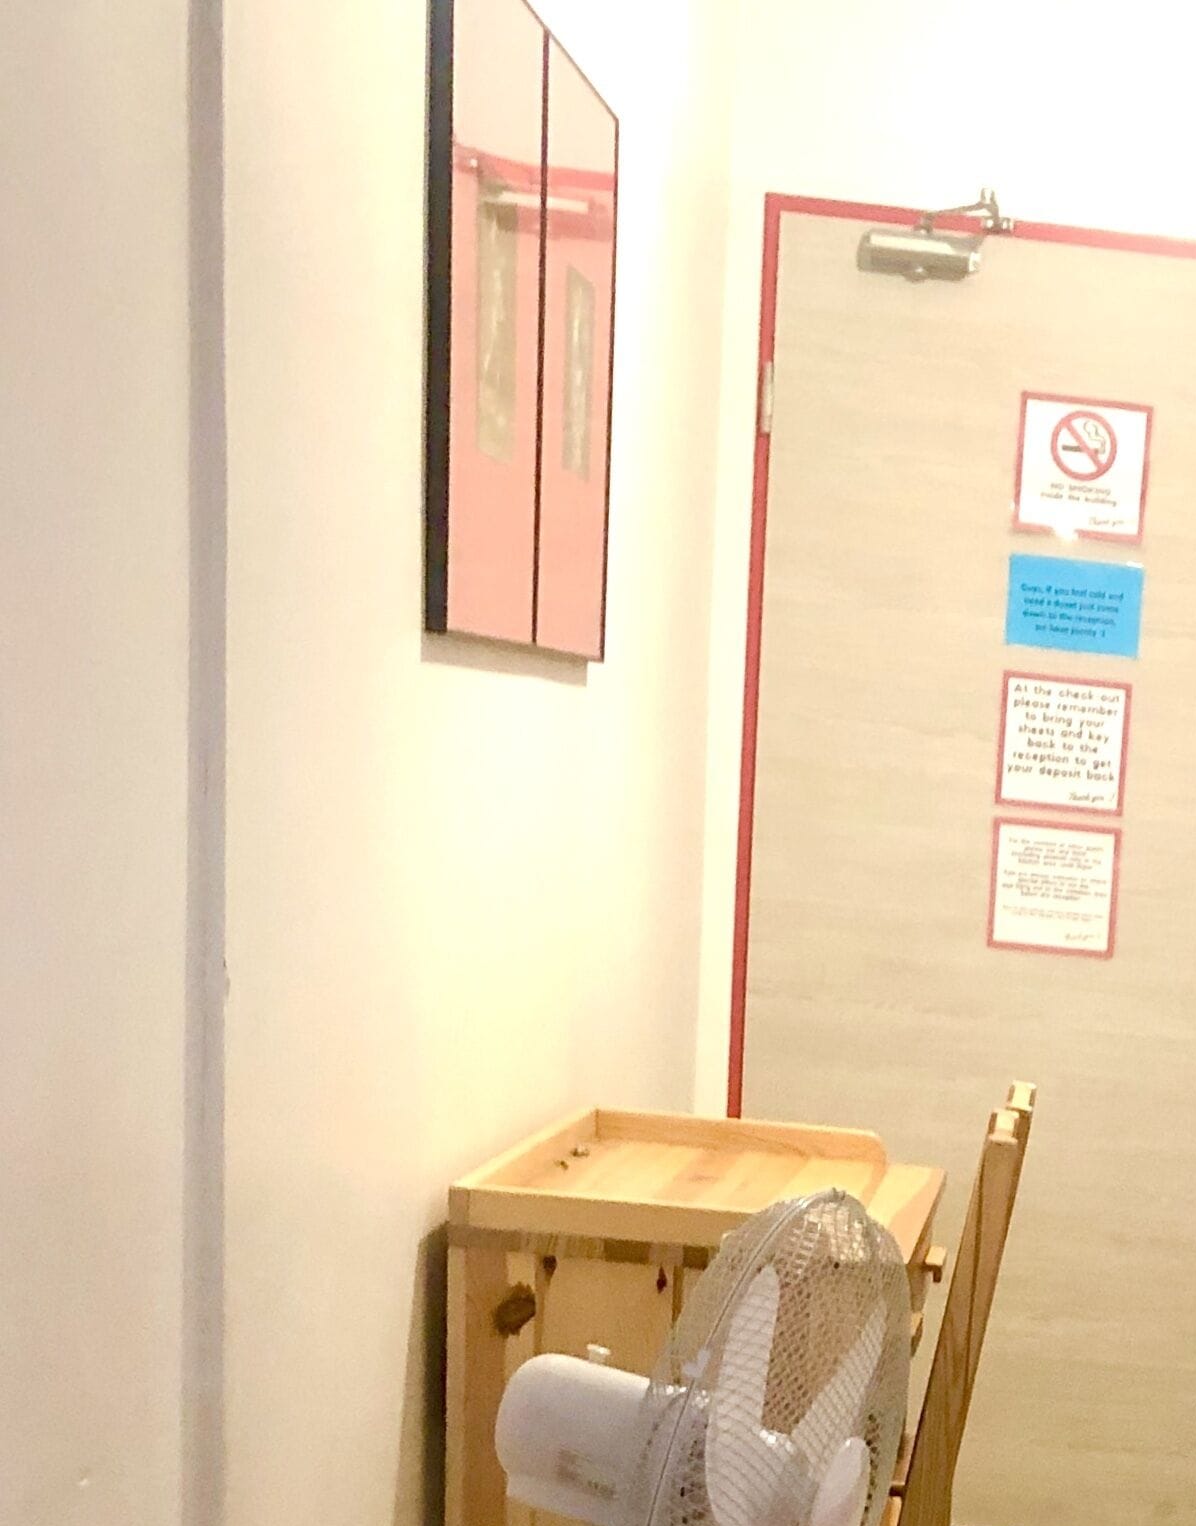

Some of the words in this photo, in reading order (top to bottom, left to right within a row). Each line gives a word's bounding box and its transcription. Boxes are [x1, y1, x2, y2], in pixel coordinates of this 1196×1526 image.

[1014, 684, 1028, 692] At
[1034, 685, 1052, 696] the
[1059, 688, 1093, 700] check
[1100, 694, 1120, 703] out
[1014, 696, 1050, 708] please
[1057, 703, 1118, 716] remember
[1025, 712, 1036, 720] to
[1042, 712, 1072, 728] bring
[1080, 720, 1104, 729] your
[1018, 724, 1054, 736] sheets
[1061, 728, 1082, 739] and
[1088, 730, 1109, 744] key
[1027, 736, 1055, 748] back
[1062, 742, 1074, 751] to
[1080, 744, 1098, 754] the
[1013, 751, 1069, 763] reception
[1075, 756, 1086, 766] to
[1093, 760, 1111, 770] get
[1008, 764, 1032, 773] your
[1039, 766, 1081, 778] deposit
[1087, 769, 1114, 782] back
